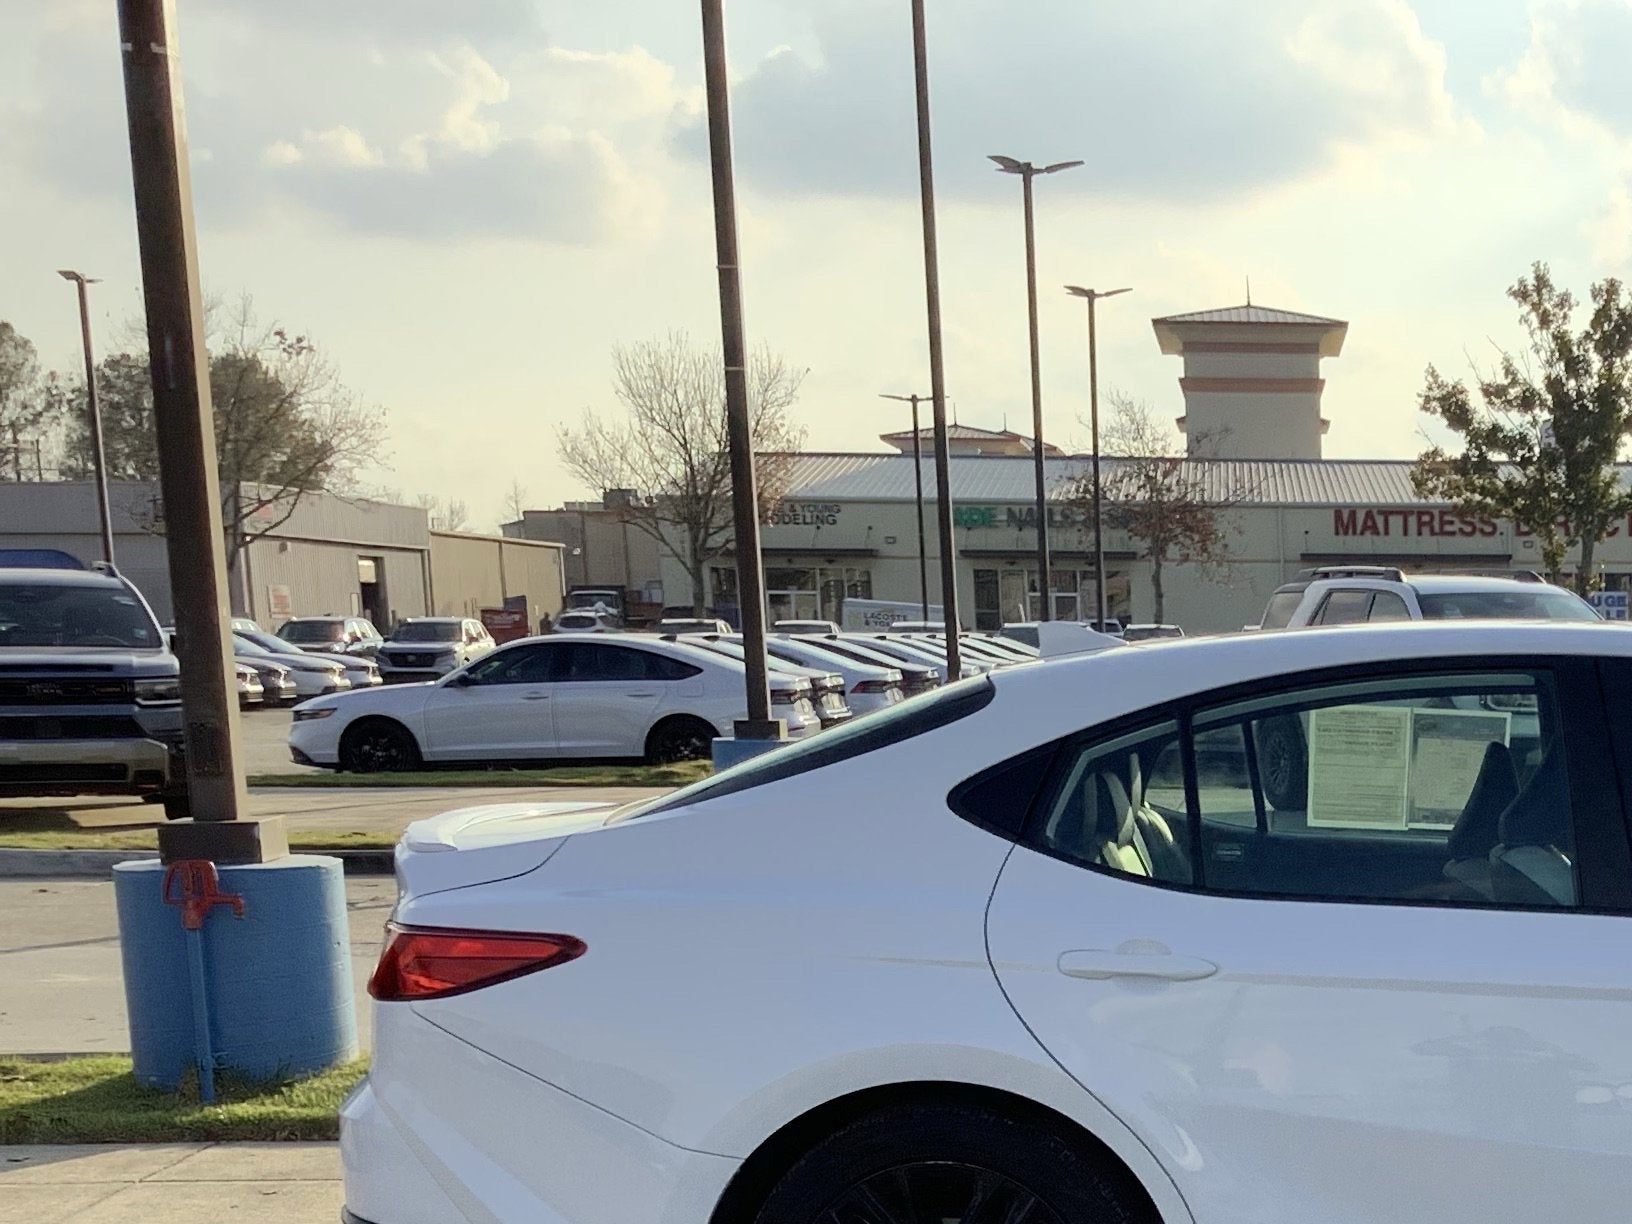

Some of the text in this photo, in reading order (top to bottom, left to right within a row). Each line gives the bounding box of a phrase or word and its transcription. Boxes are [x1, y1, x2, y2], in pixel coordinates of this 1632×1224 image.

[800, 504, 841, 514] YOUNG
[772, 513, 838, 526] ODELING
[1007, 507, 1074, 528] NALS
[1334, 509, 1497, 537] MATTRESS
[1590, 595, 1627, 607] UGE
